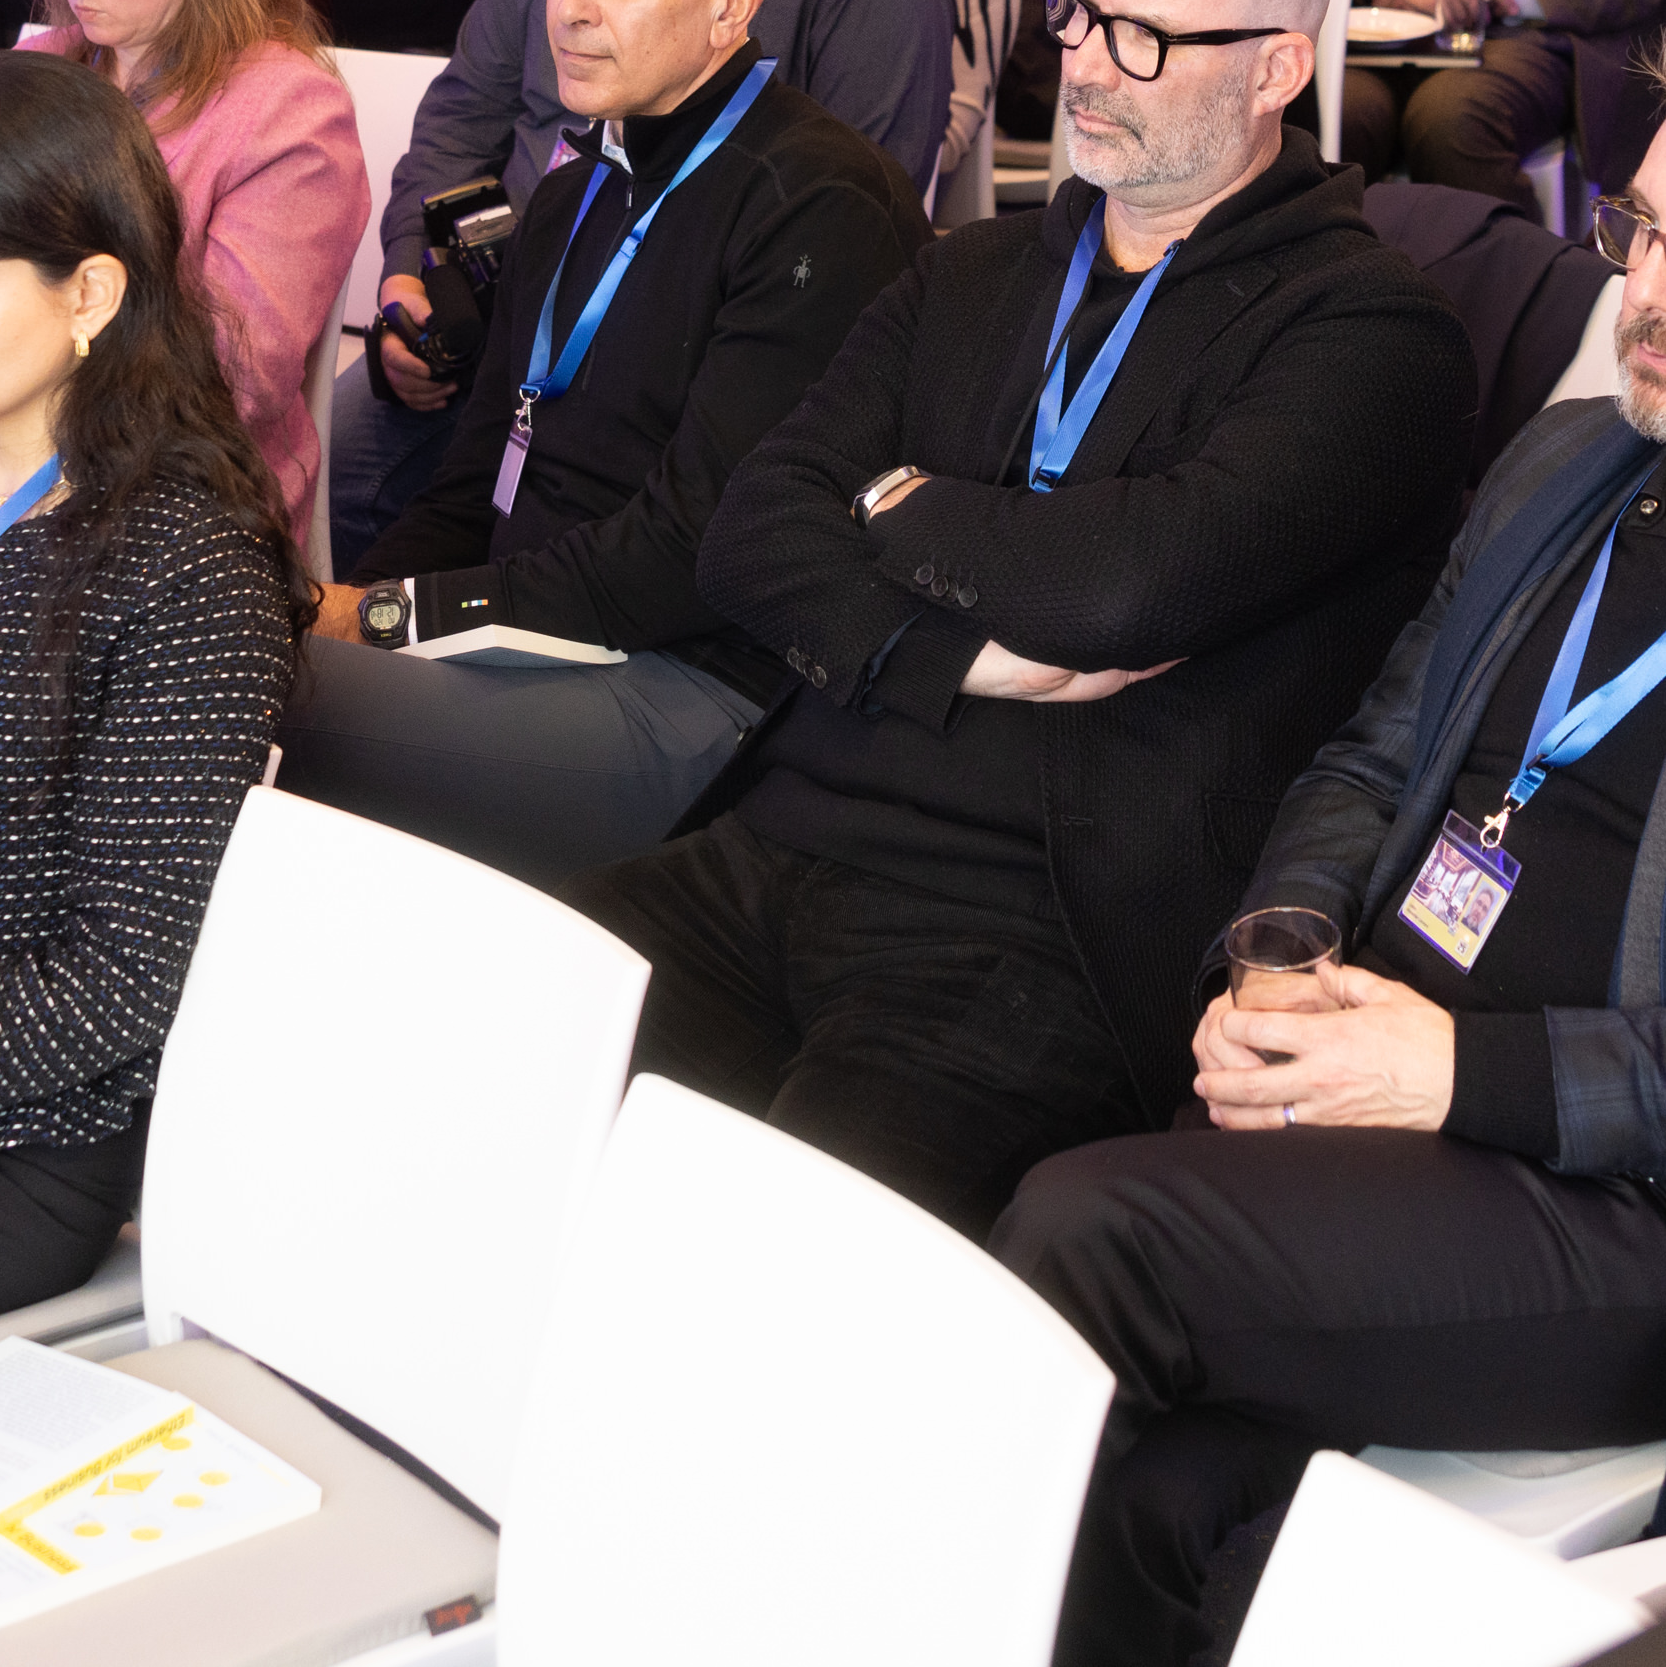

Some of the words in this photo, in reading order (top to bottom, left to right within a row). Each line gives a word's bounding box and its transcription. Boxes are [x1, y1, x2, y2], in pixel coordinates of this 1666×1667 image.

[126, 1412, 186, 1455] Ethereum
[105, 1446, 124, 1469] for
[44, 1459, 102, 1501] Business
